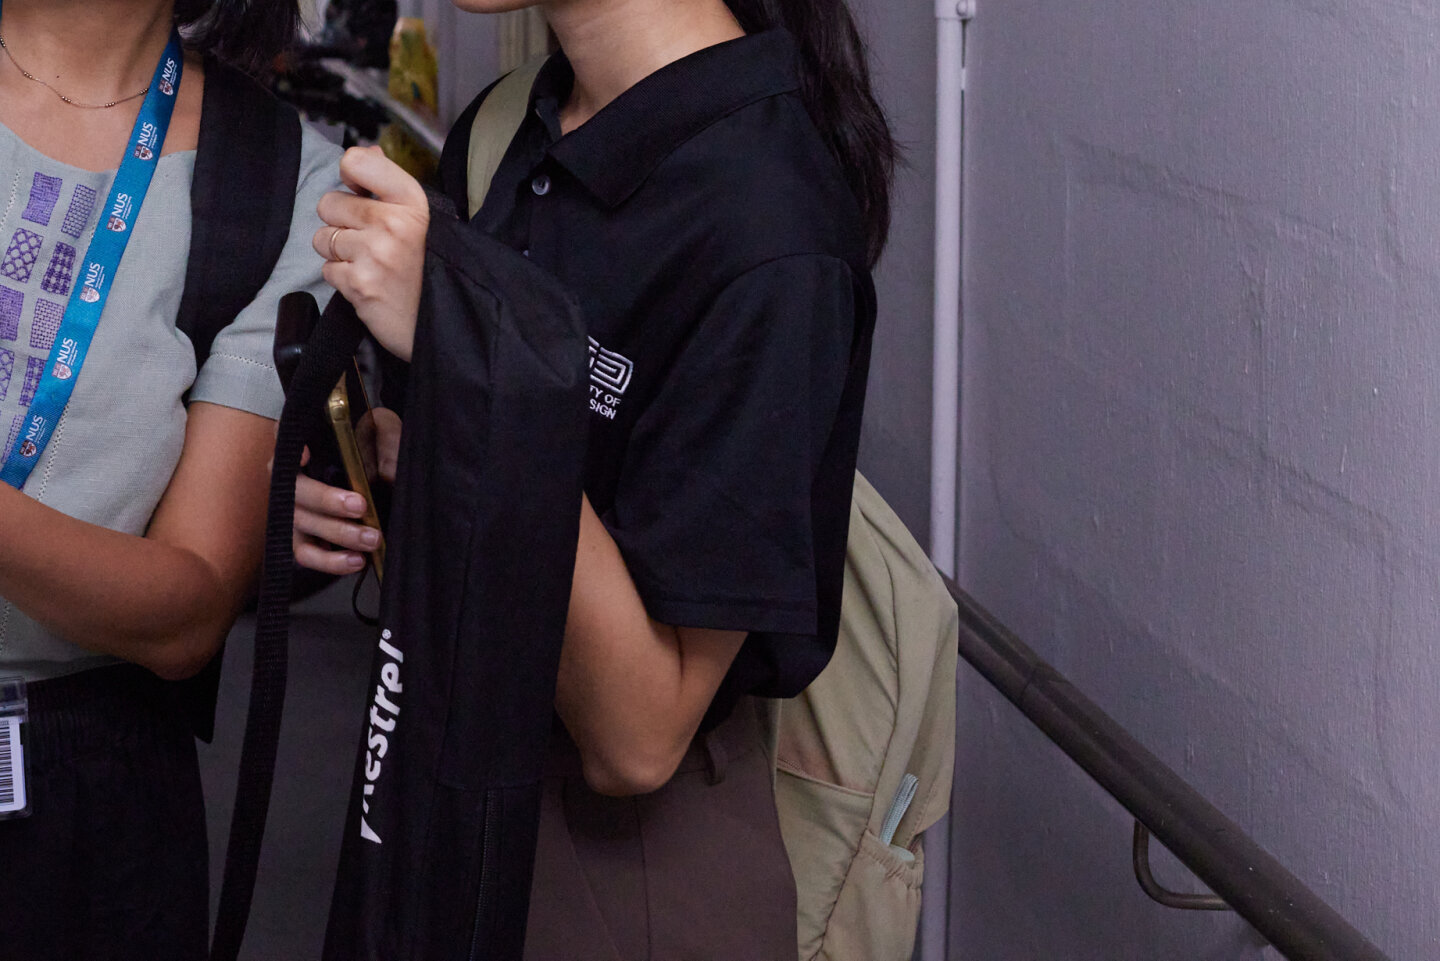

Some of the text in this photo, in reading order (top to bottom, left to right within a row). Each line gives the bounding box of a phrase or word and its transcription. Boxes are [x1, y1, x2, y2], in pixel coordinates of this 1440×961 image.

[163, 58, 175, 80] NUS
[139, 122, 153, 146] NUS
[112, 193, 128, 217] NUS
[85, 262, 100, 287] NUS
[57, 338, 73, 363] NUS
[590, 398, 616, 420] SIGN
[604, 394, 622, 407] OF
[26, 415, 43, 440] NUS
